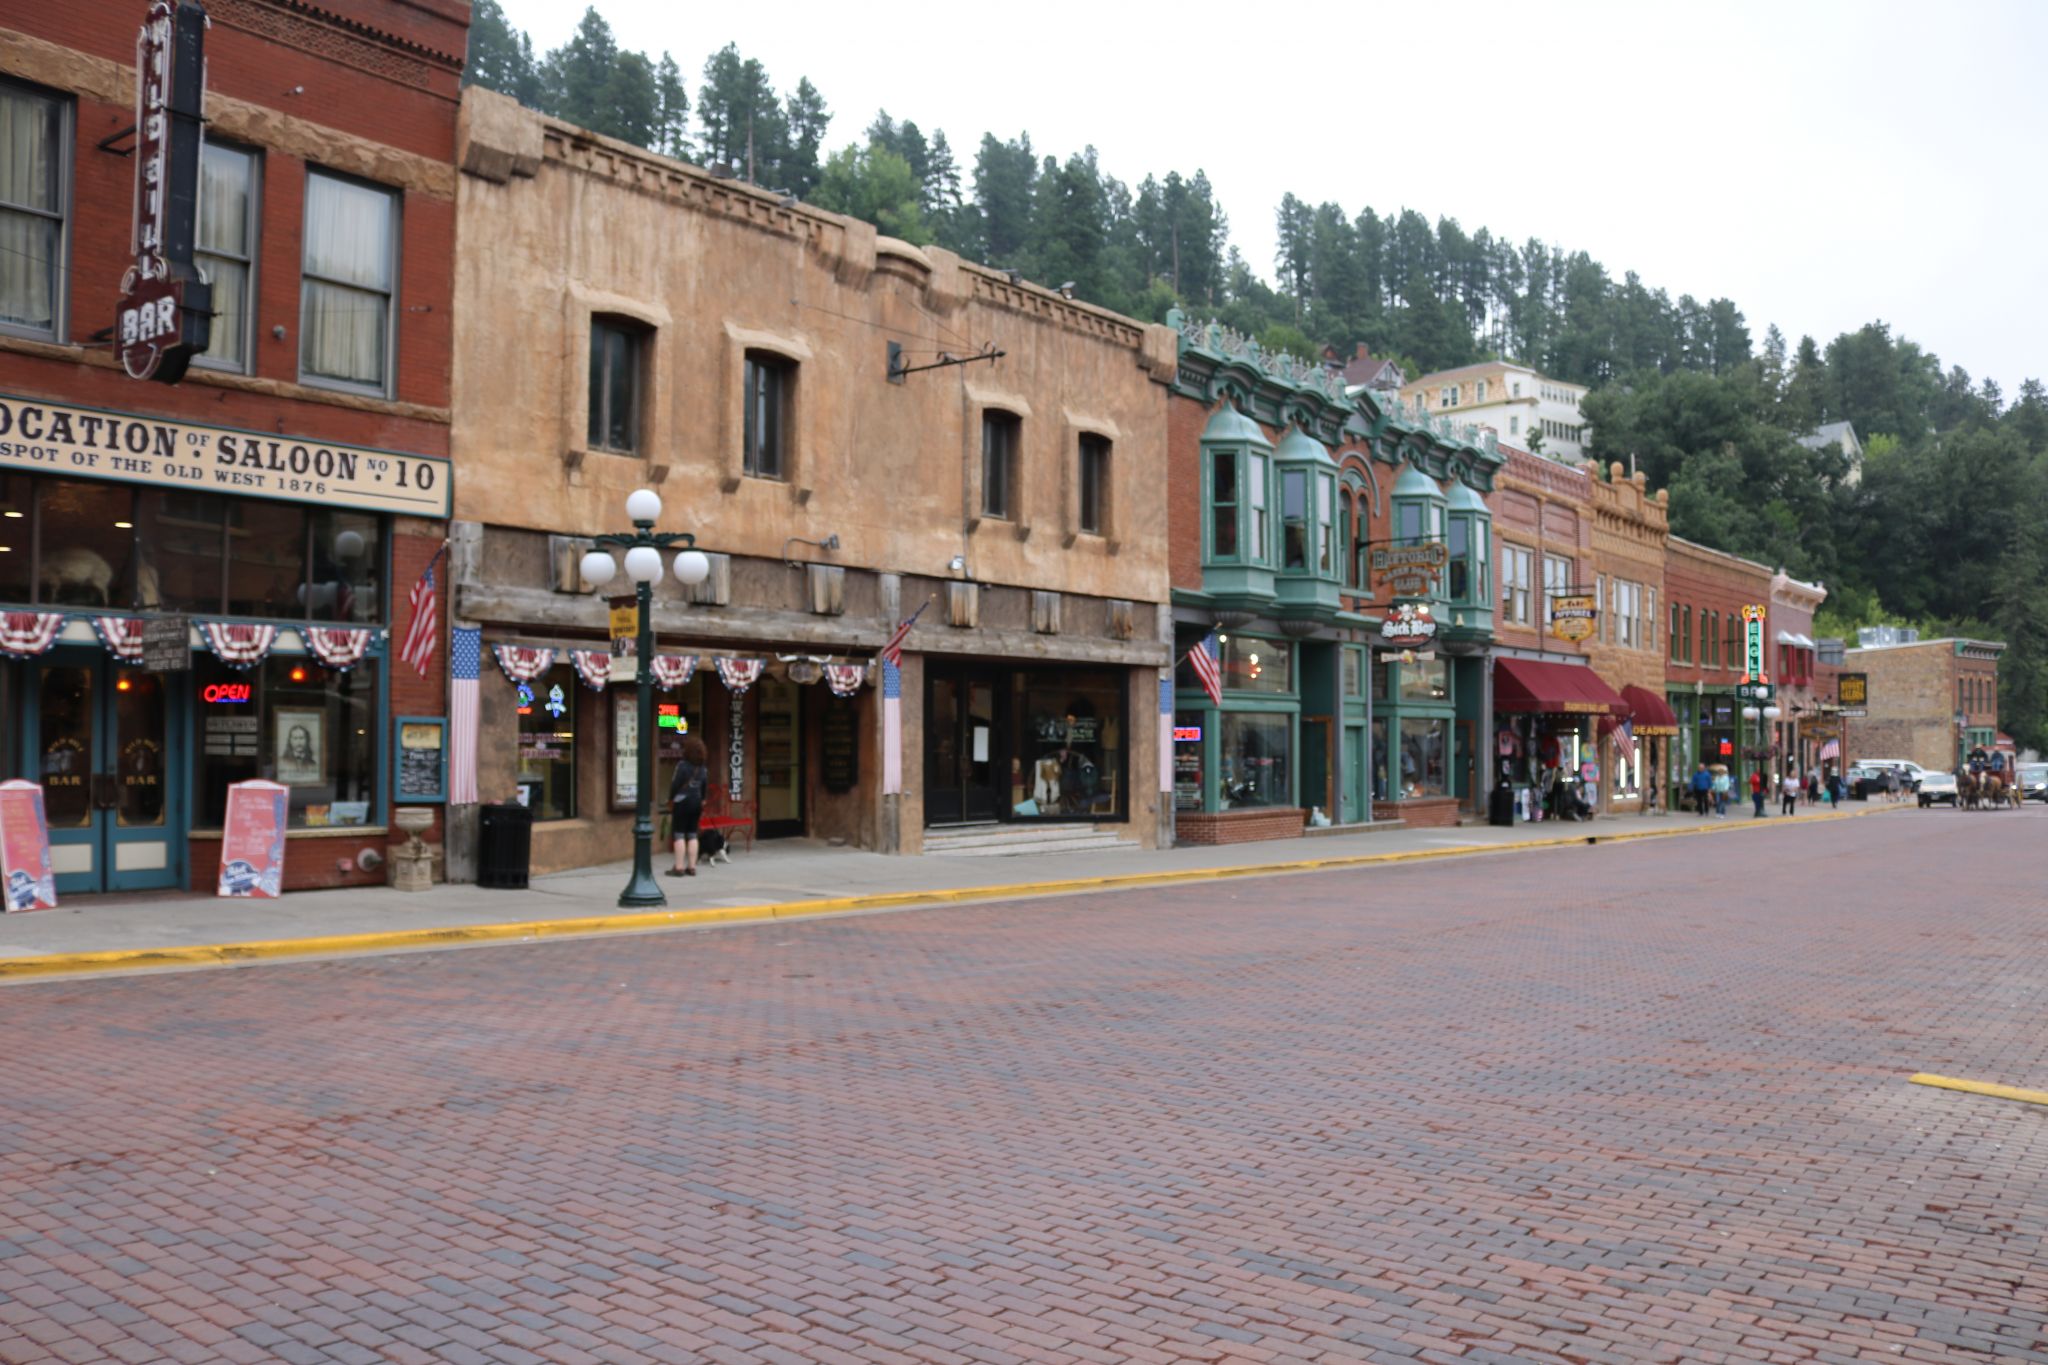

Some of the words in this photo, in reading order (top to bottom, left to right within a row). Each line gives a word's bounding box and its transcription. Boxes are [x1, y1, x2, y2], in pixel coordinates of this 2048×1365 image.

[122, 296, 176, 346] BAR
[0, 442, 59, 462] SPOT
[71, 451, 99, 467] OF
[110, 456, 152, 474] THE
[163, 463, 203, 480] OLD
[214, 468, 266, 487] WEST
[278, 477, 326, 494] 1876
[187, 433, 210, 448] OF
[216, 435, 359, 481] SALOON
[395, 460, 435, 490] 10
[1373, 544, 1445, 570] HISTORIC
[1381, 620, 1410, 638] Sick
[1410, 619, 1437, 638] Boy
[1750, 622, 1759, 681] EAGLE
[203, 684, 250, 703] OPEN
[49, 776, 81, 786] BAR
[126, 776, 157, 786] BAR
